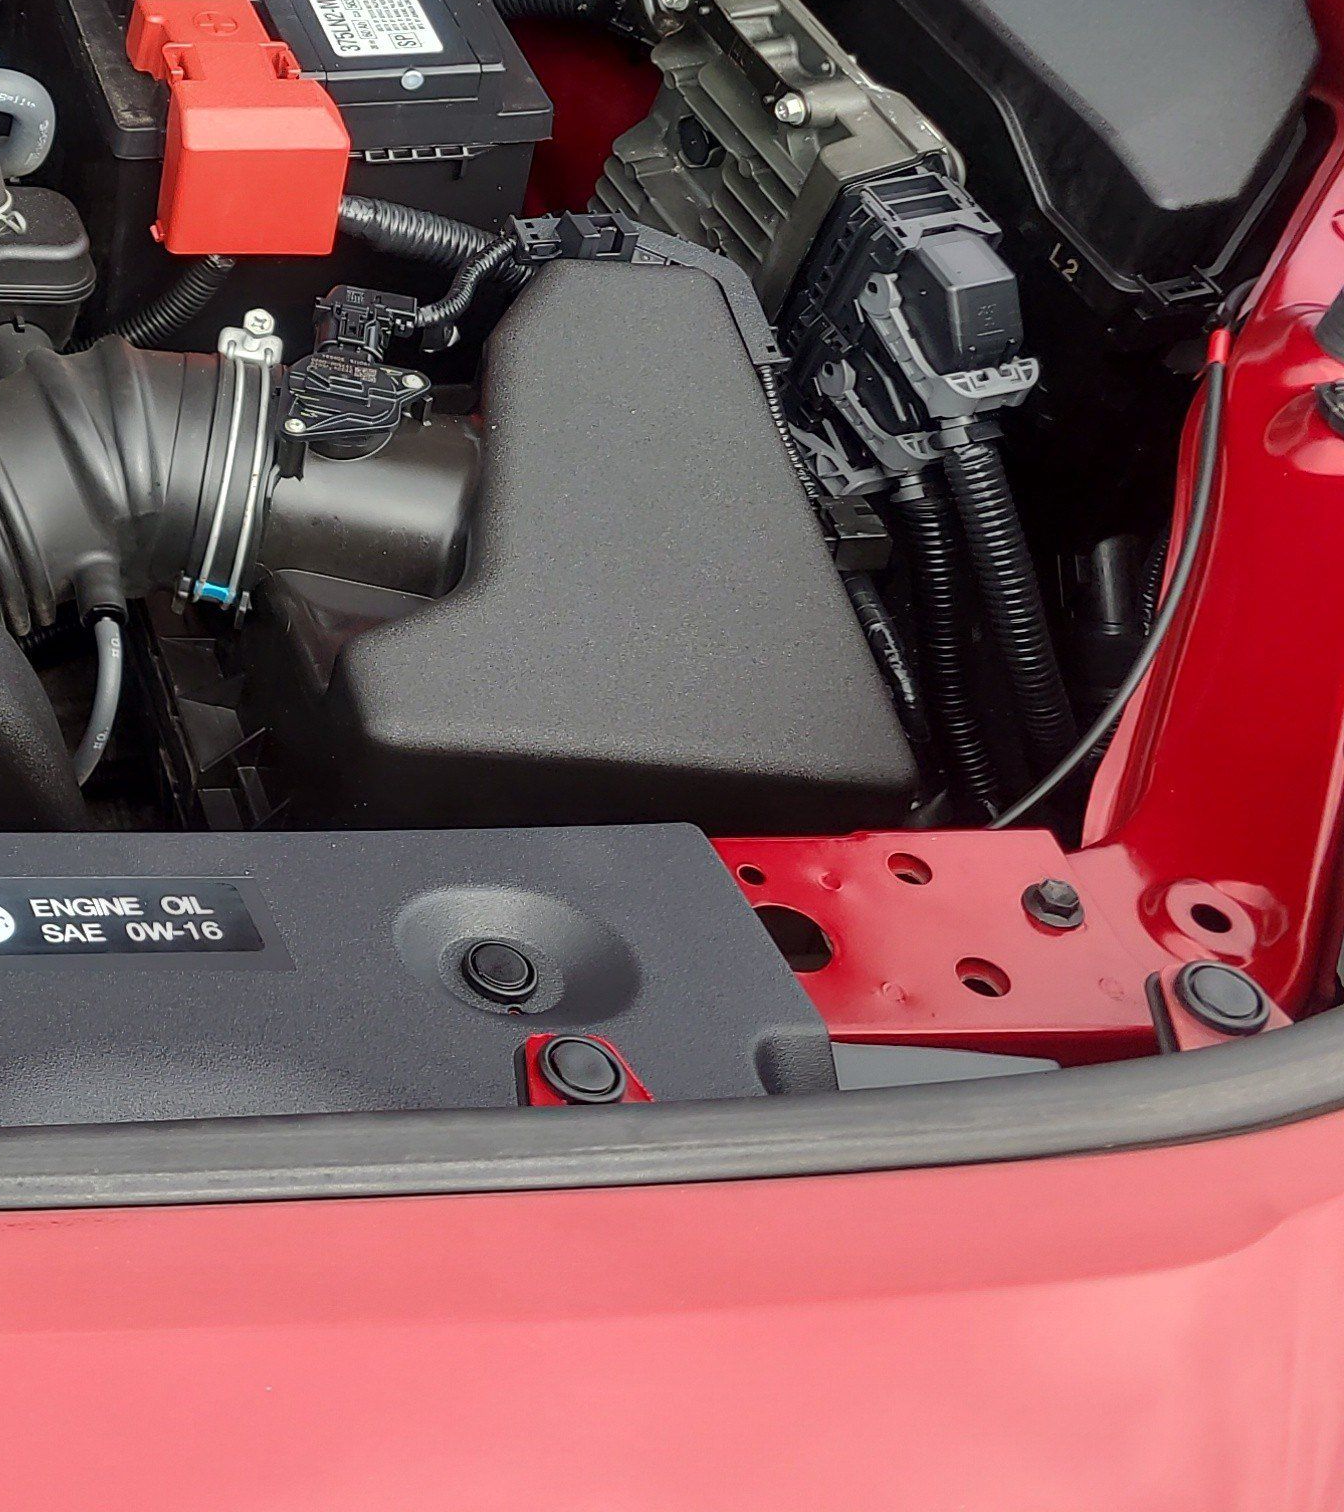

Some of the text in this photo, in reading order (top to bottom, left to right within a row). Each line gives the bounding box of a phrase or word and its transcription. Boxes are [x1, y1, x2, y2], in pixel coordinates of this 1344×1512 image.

[1049, 242, 1079, 282] L2
[28, 895, 216, 919] ENGINE OIL
[41, 920, 225, 945] SAE 0W-16
